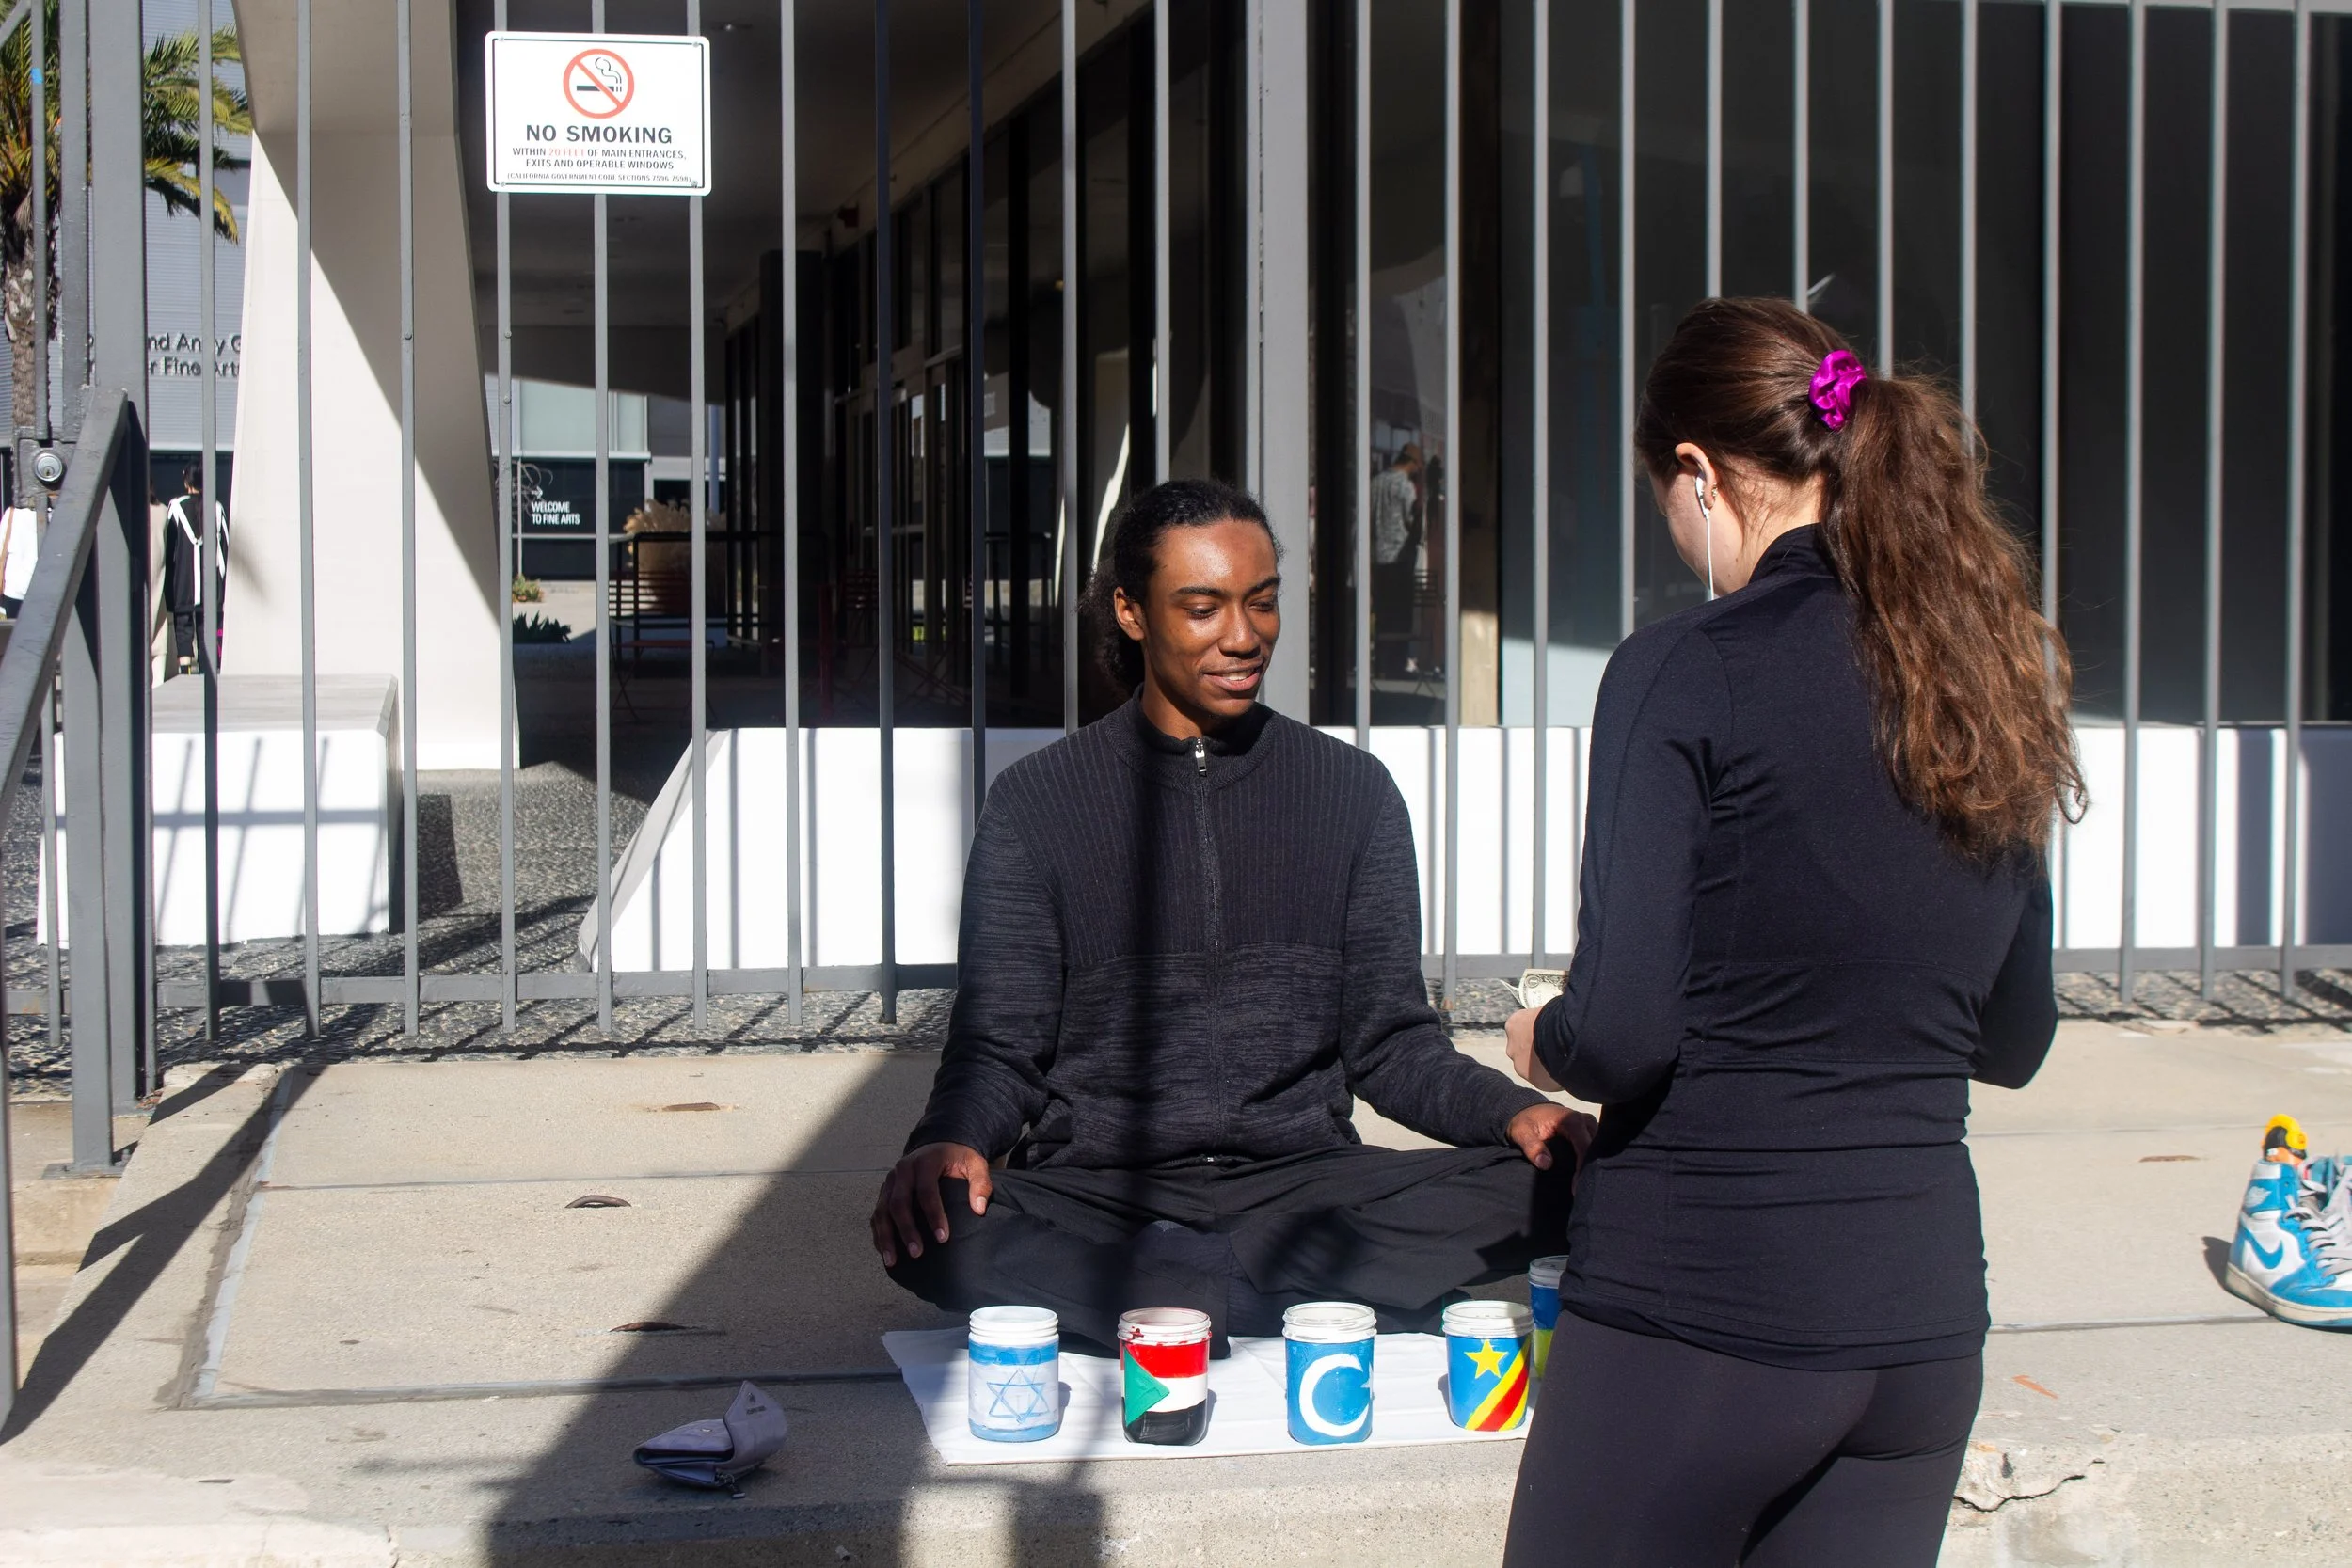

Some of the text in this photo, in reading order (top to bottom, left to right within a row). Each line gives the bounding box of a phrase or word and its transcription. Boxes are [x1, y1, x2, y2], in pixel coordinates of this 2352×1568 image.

[526, 124, 672, 144] NO SMOKING
[512, 147, 687, 160] WITHIN 20 FEET OF MAIN ENTRANCES,
[526, 158, 675, 170] EXITS AND OPERABLE WINDOWS
[163, 356, 202, 376] Fine
[532, 501, 570, 513] WELCOME
[532, 514, 580, 525] TO FINE ARTS
